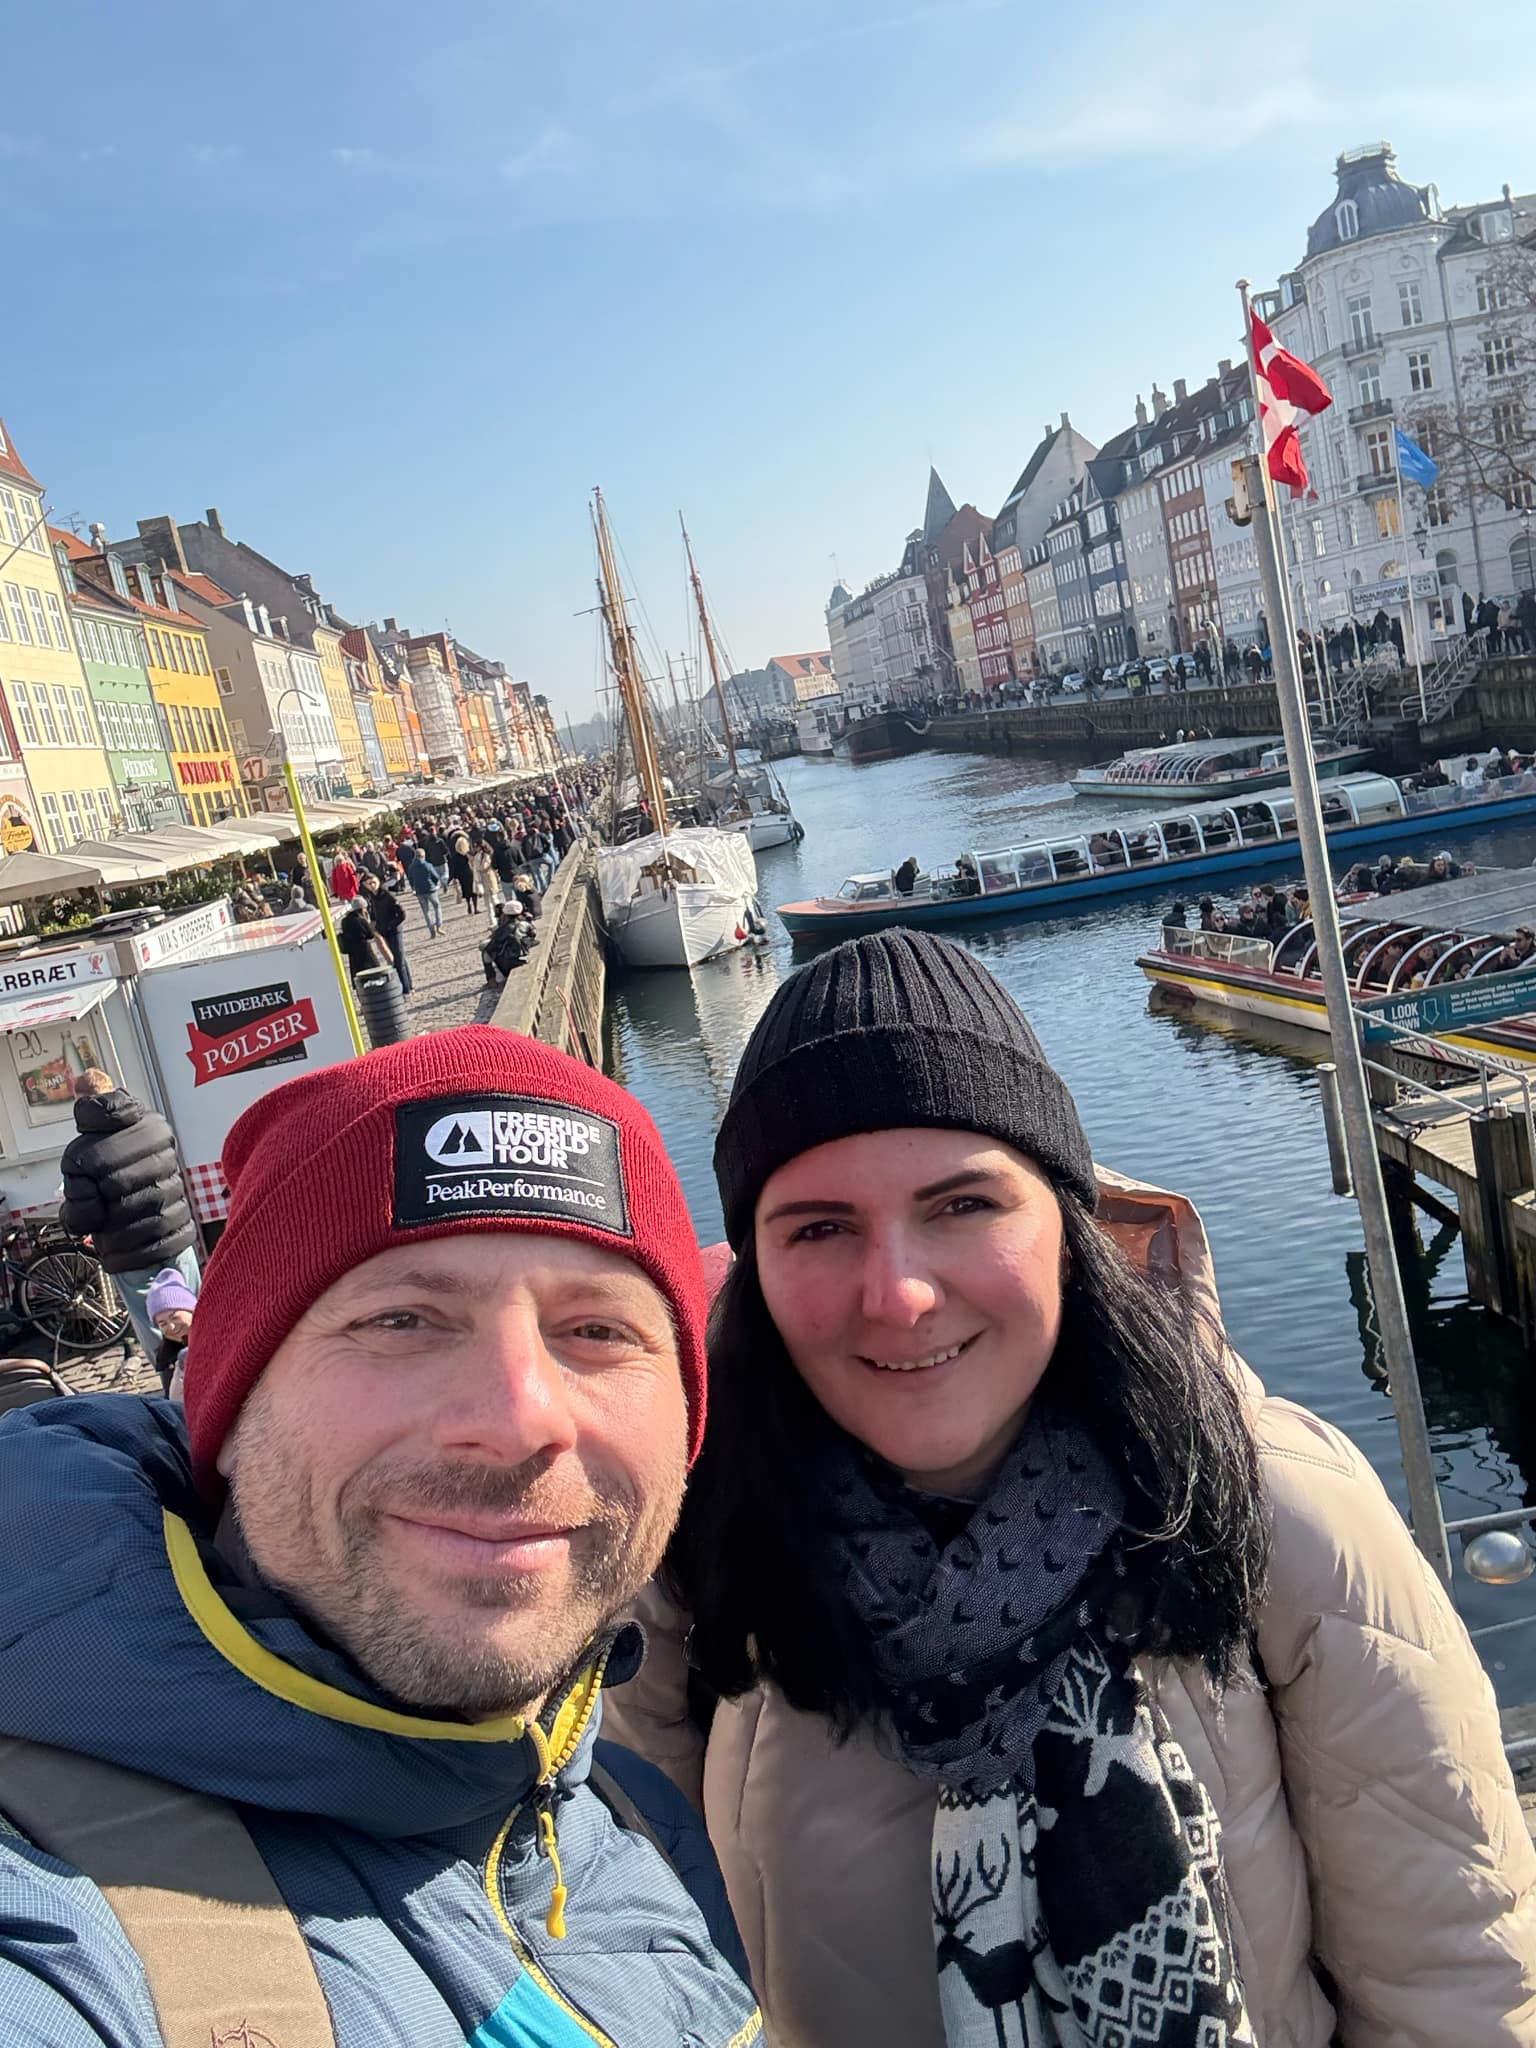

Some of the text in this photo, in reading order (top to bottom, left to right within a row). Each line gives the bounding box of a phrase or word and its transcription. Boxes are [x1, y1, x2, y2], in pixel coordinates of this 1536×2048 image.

[243, 759, 265, 779] 17
[0, 962, 77, 992] RBRÆT
[199, 990, 289, 1020] HVIDEBÆK
[1391, 1002, 1419, 1020] LOOK
[203, 1012, 308, 1073] PØLSER
[493, 1111, 601, 1145] FREERIDE
[493, 1126, 590, 1155] WORLD
[495, 1144, 569, 1169] TOUR
[426, 1178, 606, 1210] PeakPerformance
